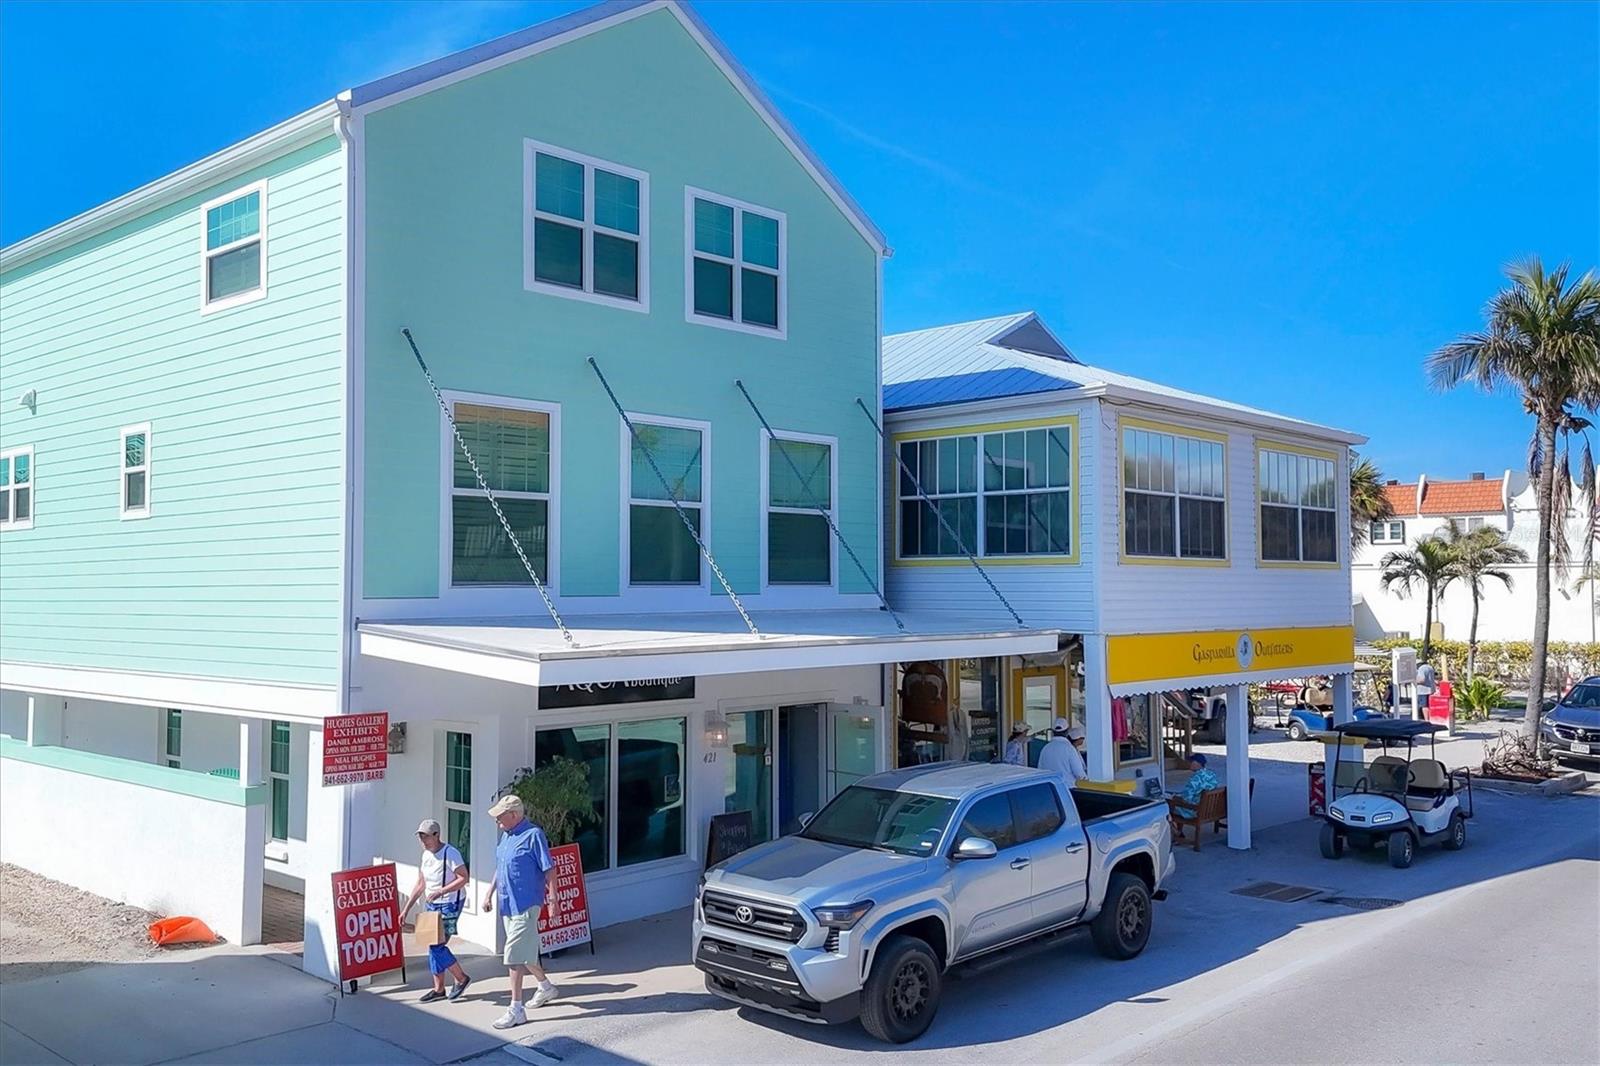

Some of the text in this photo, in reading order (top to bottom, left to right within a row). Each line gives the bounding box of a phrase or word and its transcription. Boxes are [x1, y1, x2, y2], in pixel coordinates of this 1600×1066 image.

[326, 715, 386, 729] HUGHES GALLERY
[333, 726, 380, 737] EXHIBITS
[327, 735, 384, 747] DANIEL AMBROSE
[334, 754, 376, 764] NEAL HUGHES
[703, 752, 717, 764] 421
[337, 873, 393, 895] HUGHES
[337, 886, 395, 910] GALLERY
[345, 907, 393, 938] OPEN
[537, 909, 587, 931] UP ONE FLIGHT
[541, 926, 588, 948] 941-662-9970
[341, 932, 399, 967] TODAY
